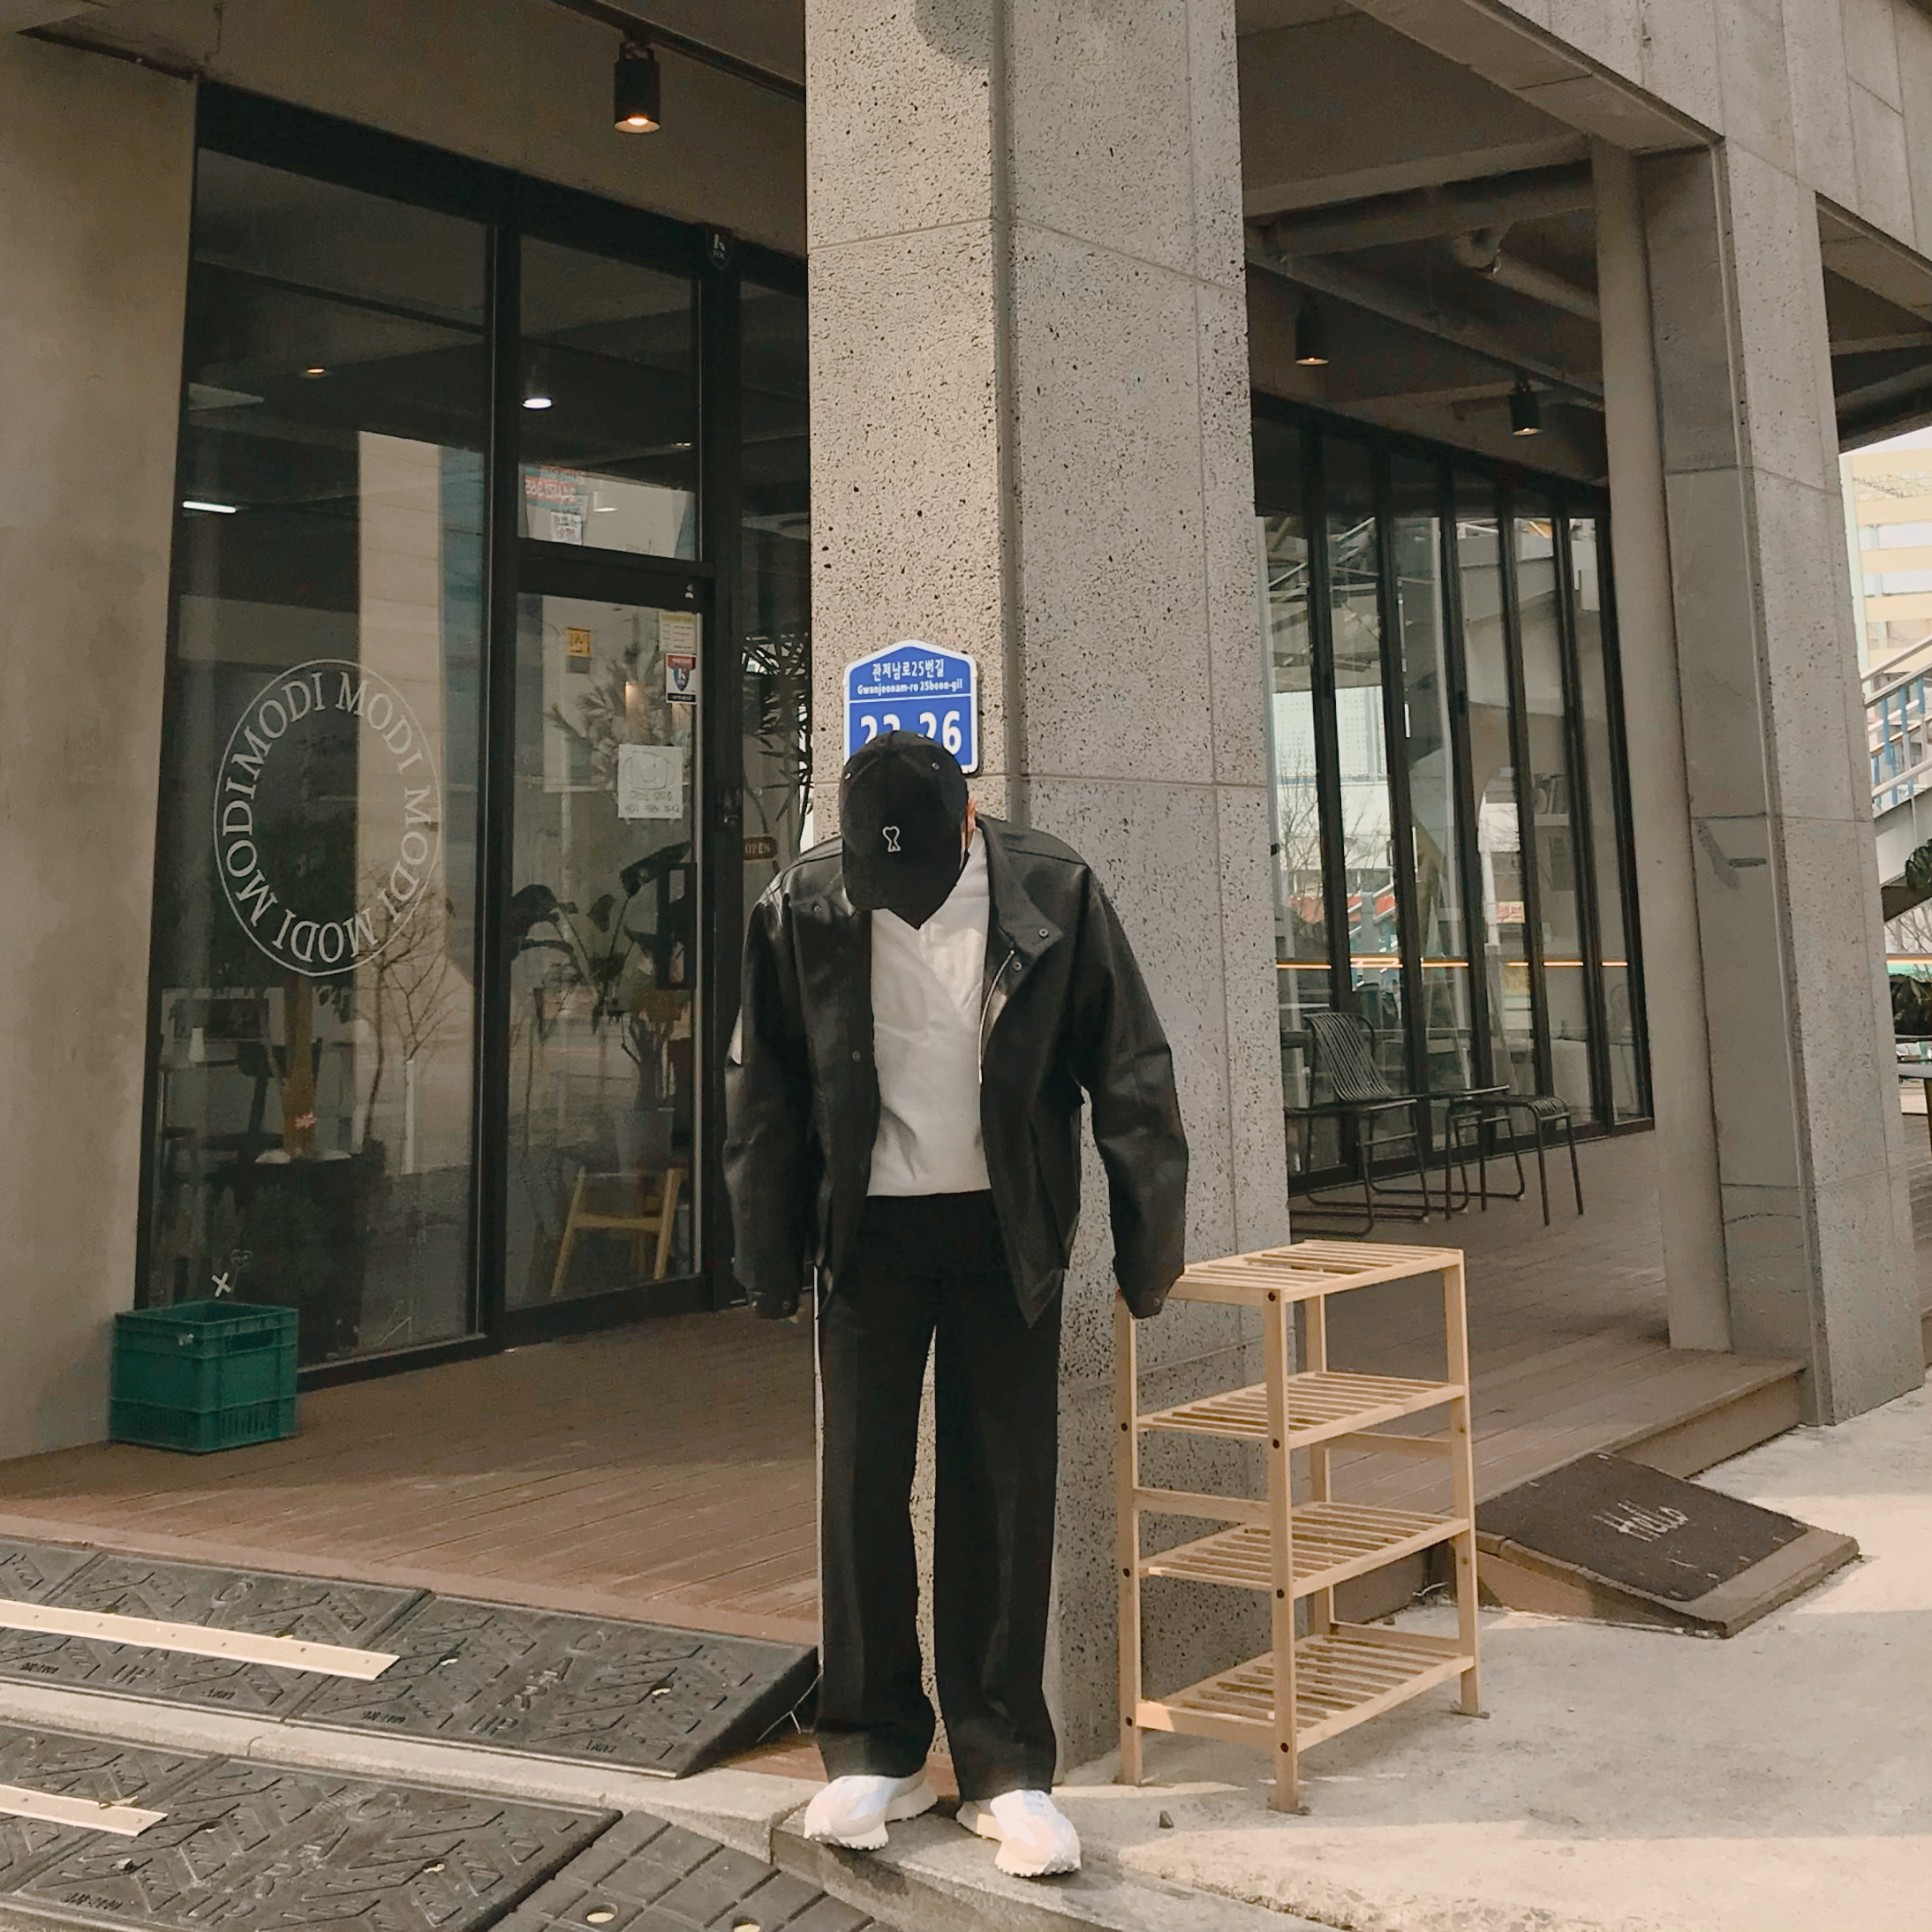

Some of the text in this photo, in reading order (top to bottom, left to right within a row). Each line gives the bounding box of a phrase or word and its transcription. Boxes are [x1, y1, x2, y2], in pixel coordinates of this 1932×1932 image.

[335, 671, 424, 775] MODI
[872, 659, 944, 682] 관저남로25번길
[230, 672, 325, 781] MODI
[223, 777, 278, 927] MODI
[377, 785, 432, 924] MODI
[272, 907, 379, 963] MODI
